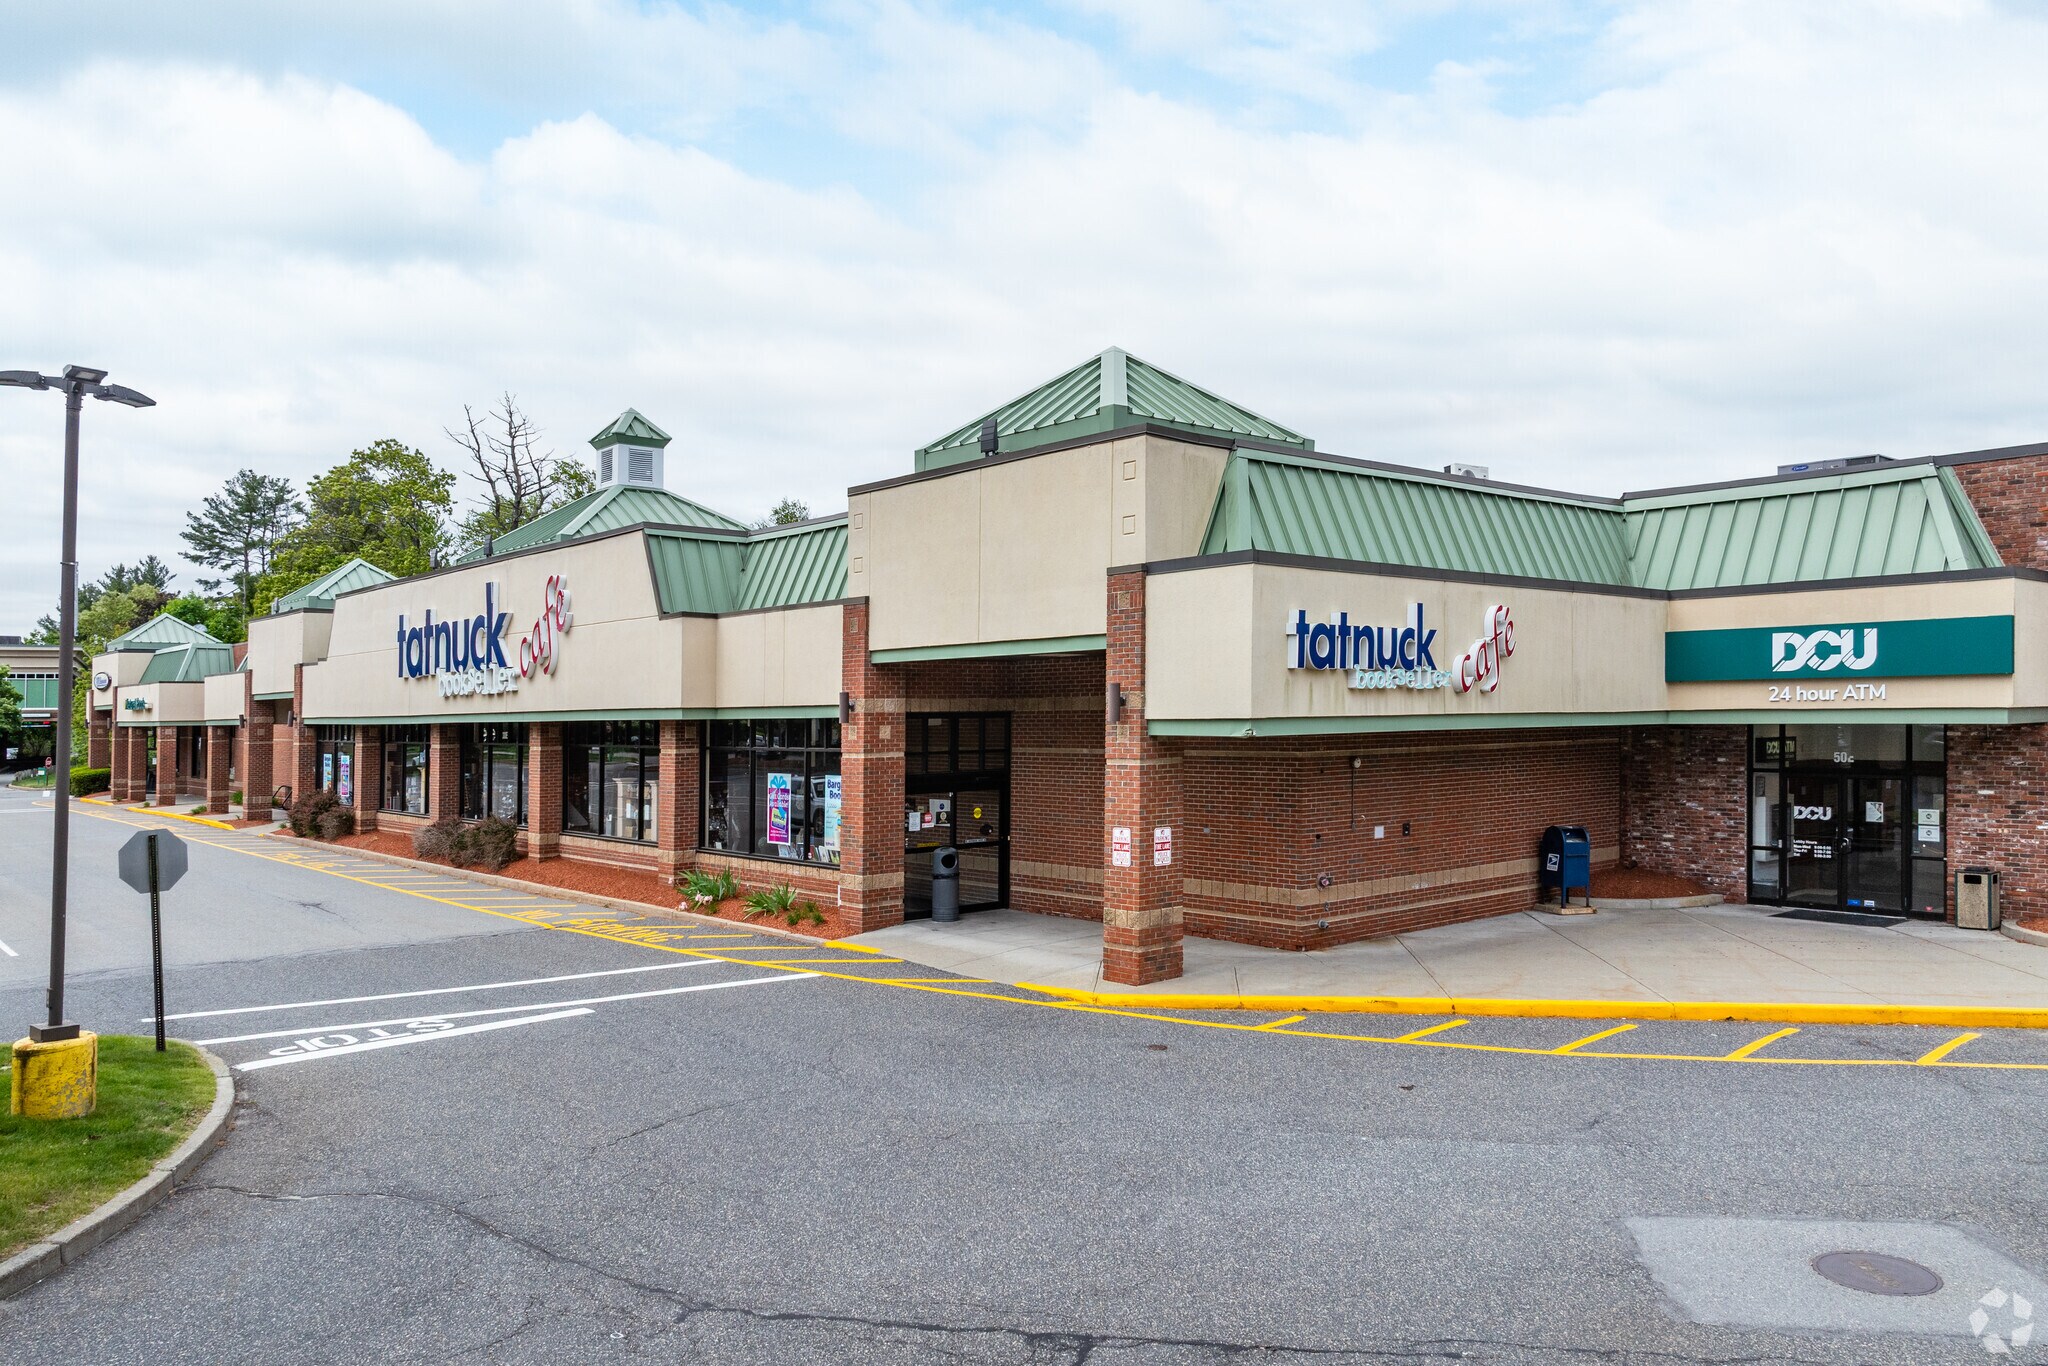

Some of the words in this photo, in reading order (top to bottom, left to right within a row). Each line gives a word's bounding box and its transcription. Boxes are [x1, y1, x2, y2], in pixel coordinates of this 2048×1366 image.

[397, 581, 514, 679] tatnuck
[1286, 602, 1438, 670] tatnuck
[1771, 628, 1878, 672] DCU
[436, 662, 521, 698] bookseller
[1349, 663, 1454, 690] bookseller
[1768, 685, 1792, 702] 24
[1795, 685, 1839, 702] hour
[1842, 683, 1886, 701] ATM
[1793, 805, 1832, 821] DCU
[267, 1018, 456, 1058] STOP
